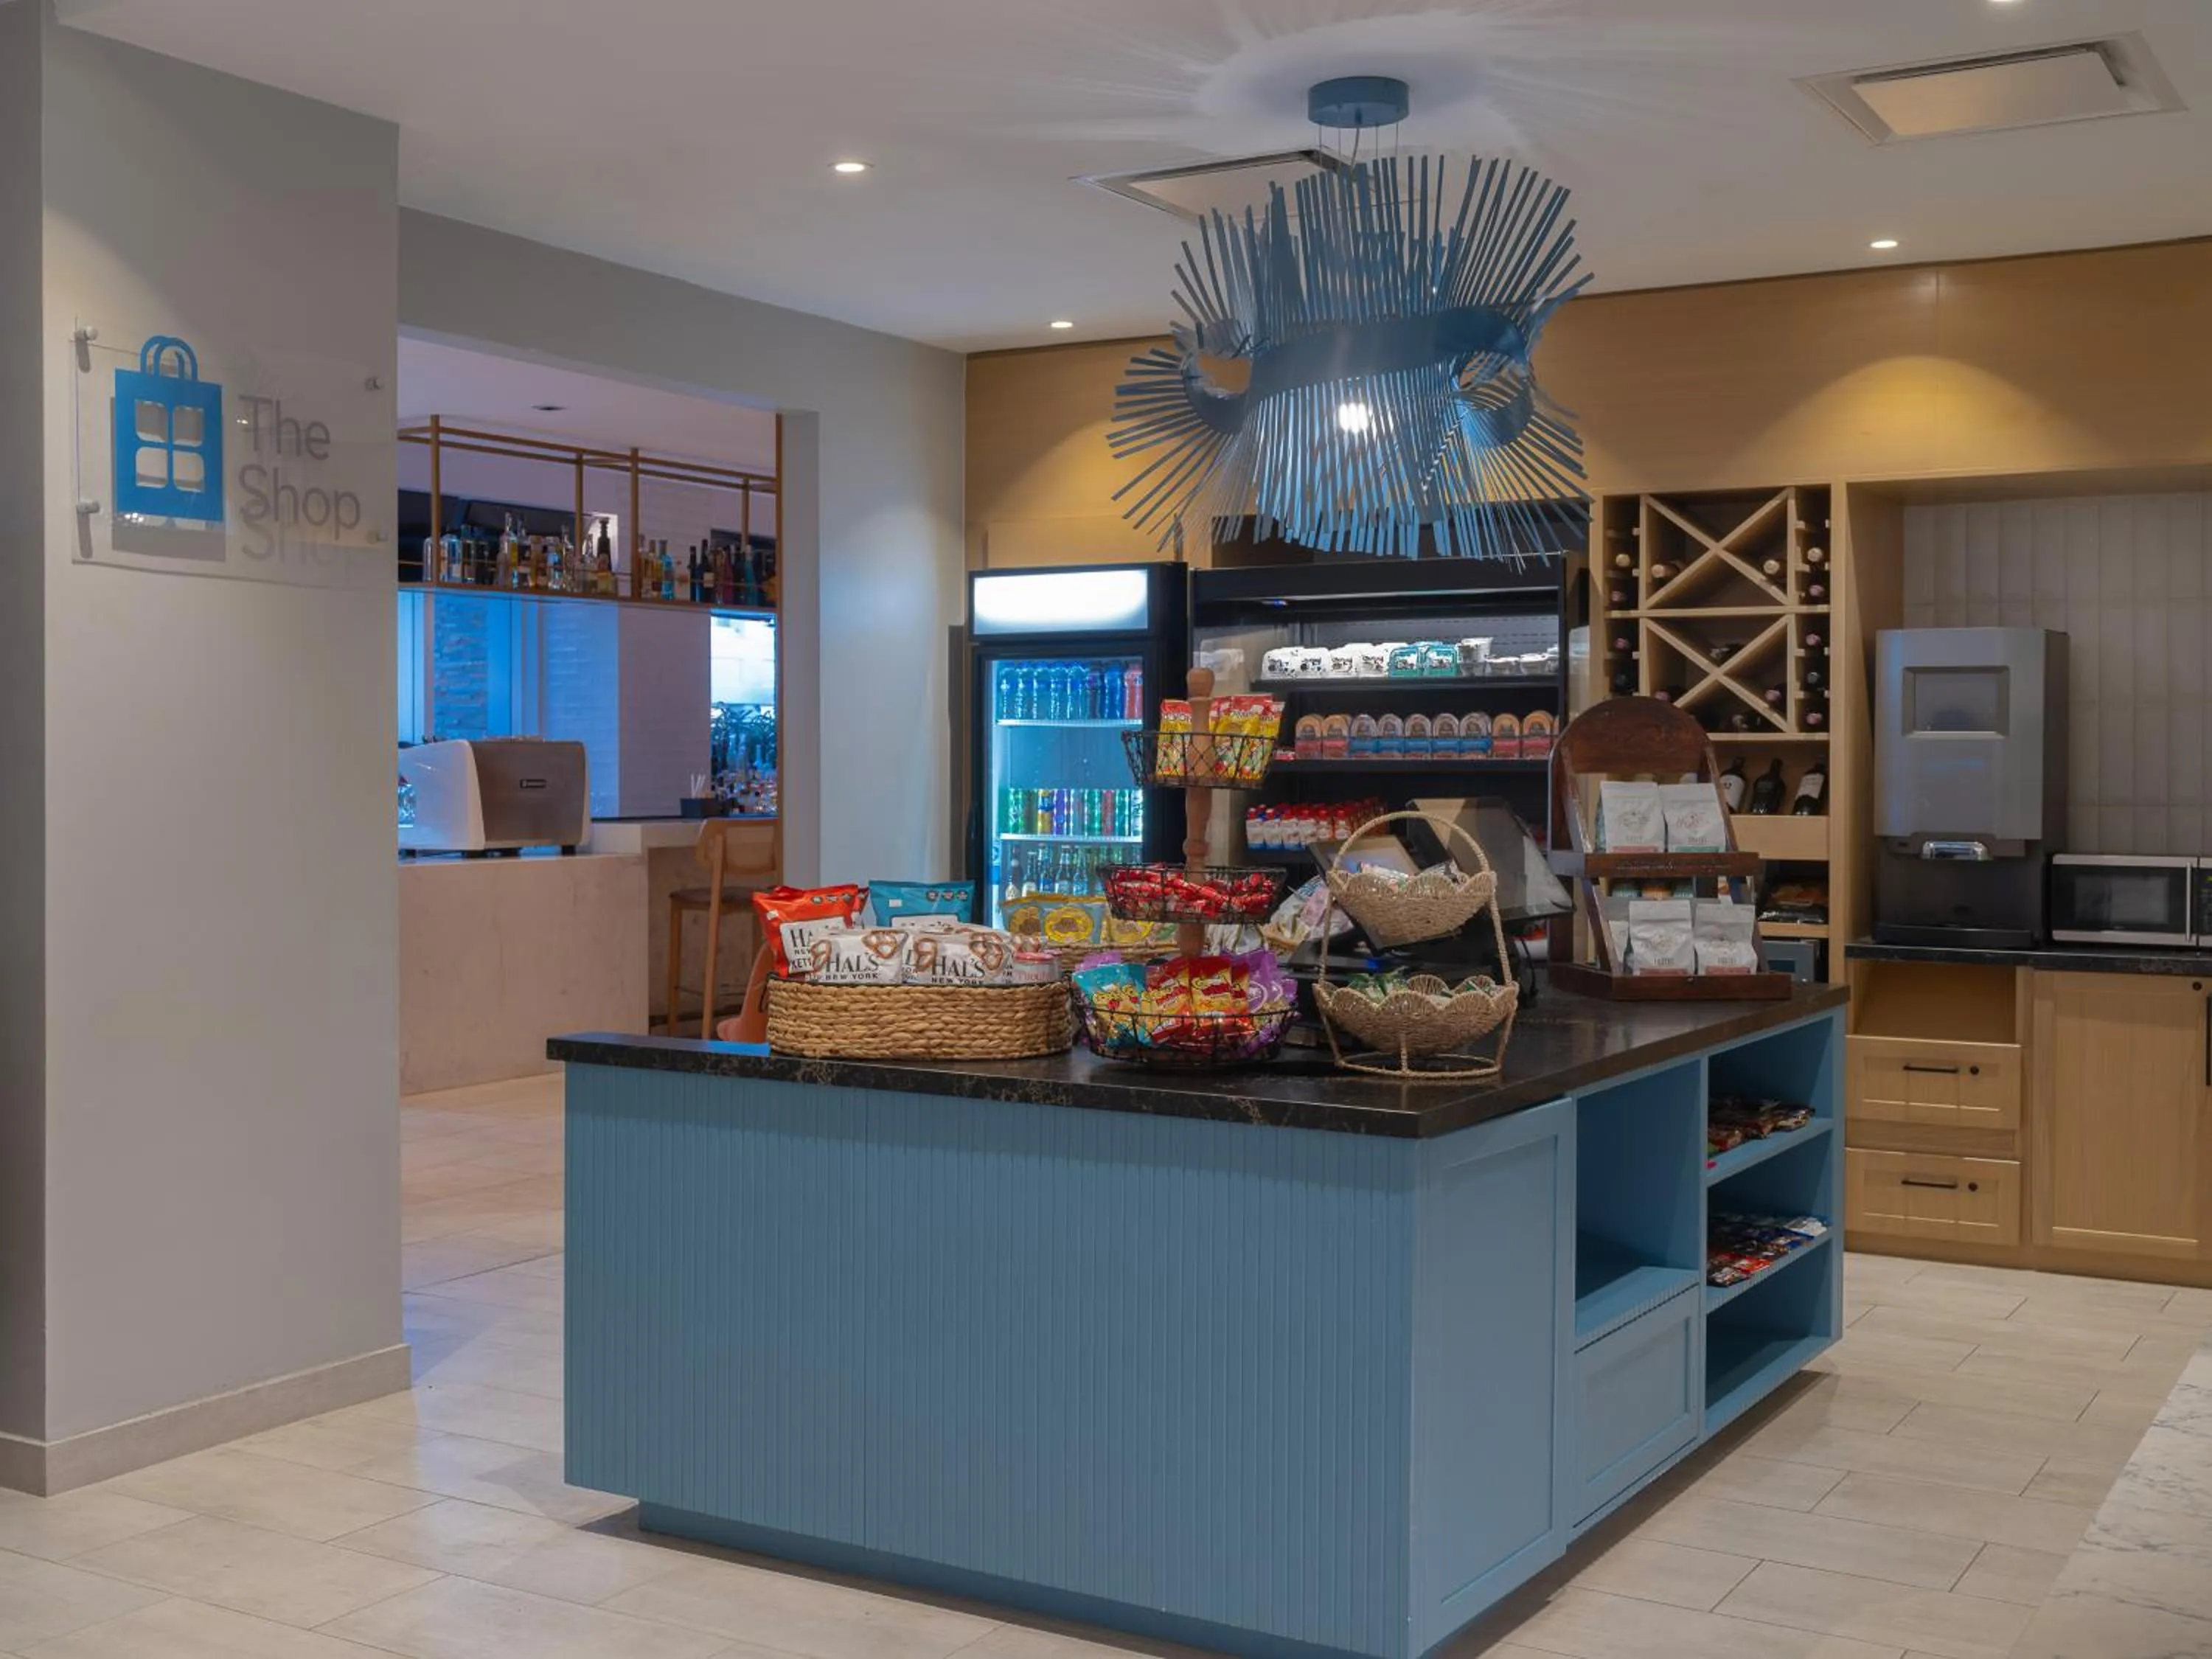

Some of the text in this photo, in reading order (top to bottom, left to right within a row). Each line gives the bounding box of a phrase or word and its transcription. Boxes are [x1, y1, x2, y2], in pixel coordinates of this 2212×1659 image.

[238, 394, 330, 460] The
[239, 464, 361, 540] Shop
[825, 952, 879, 972] HAL'S
[931, 956, 986, 978] HAL'S
[852, 972, 879, 980] YORK
